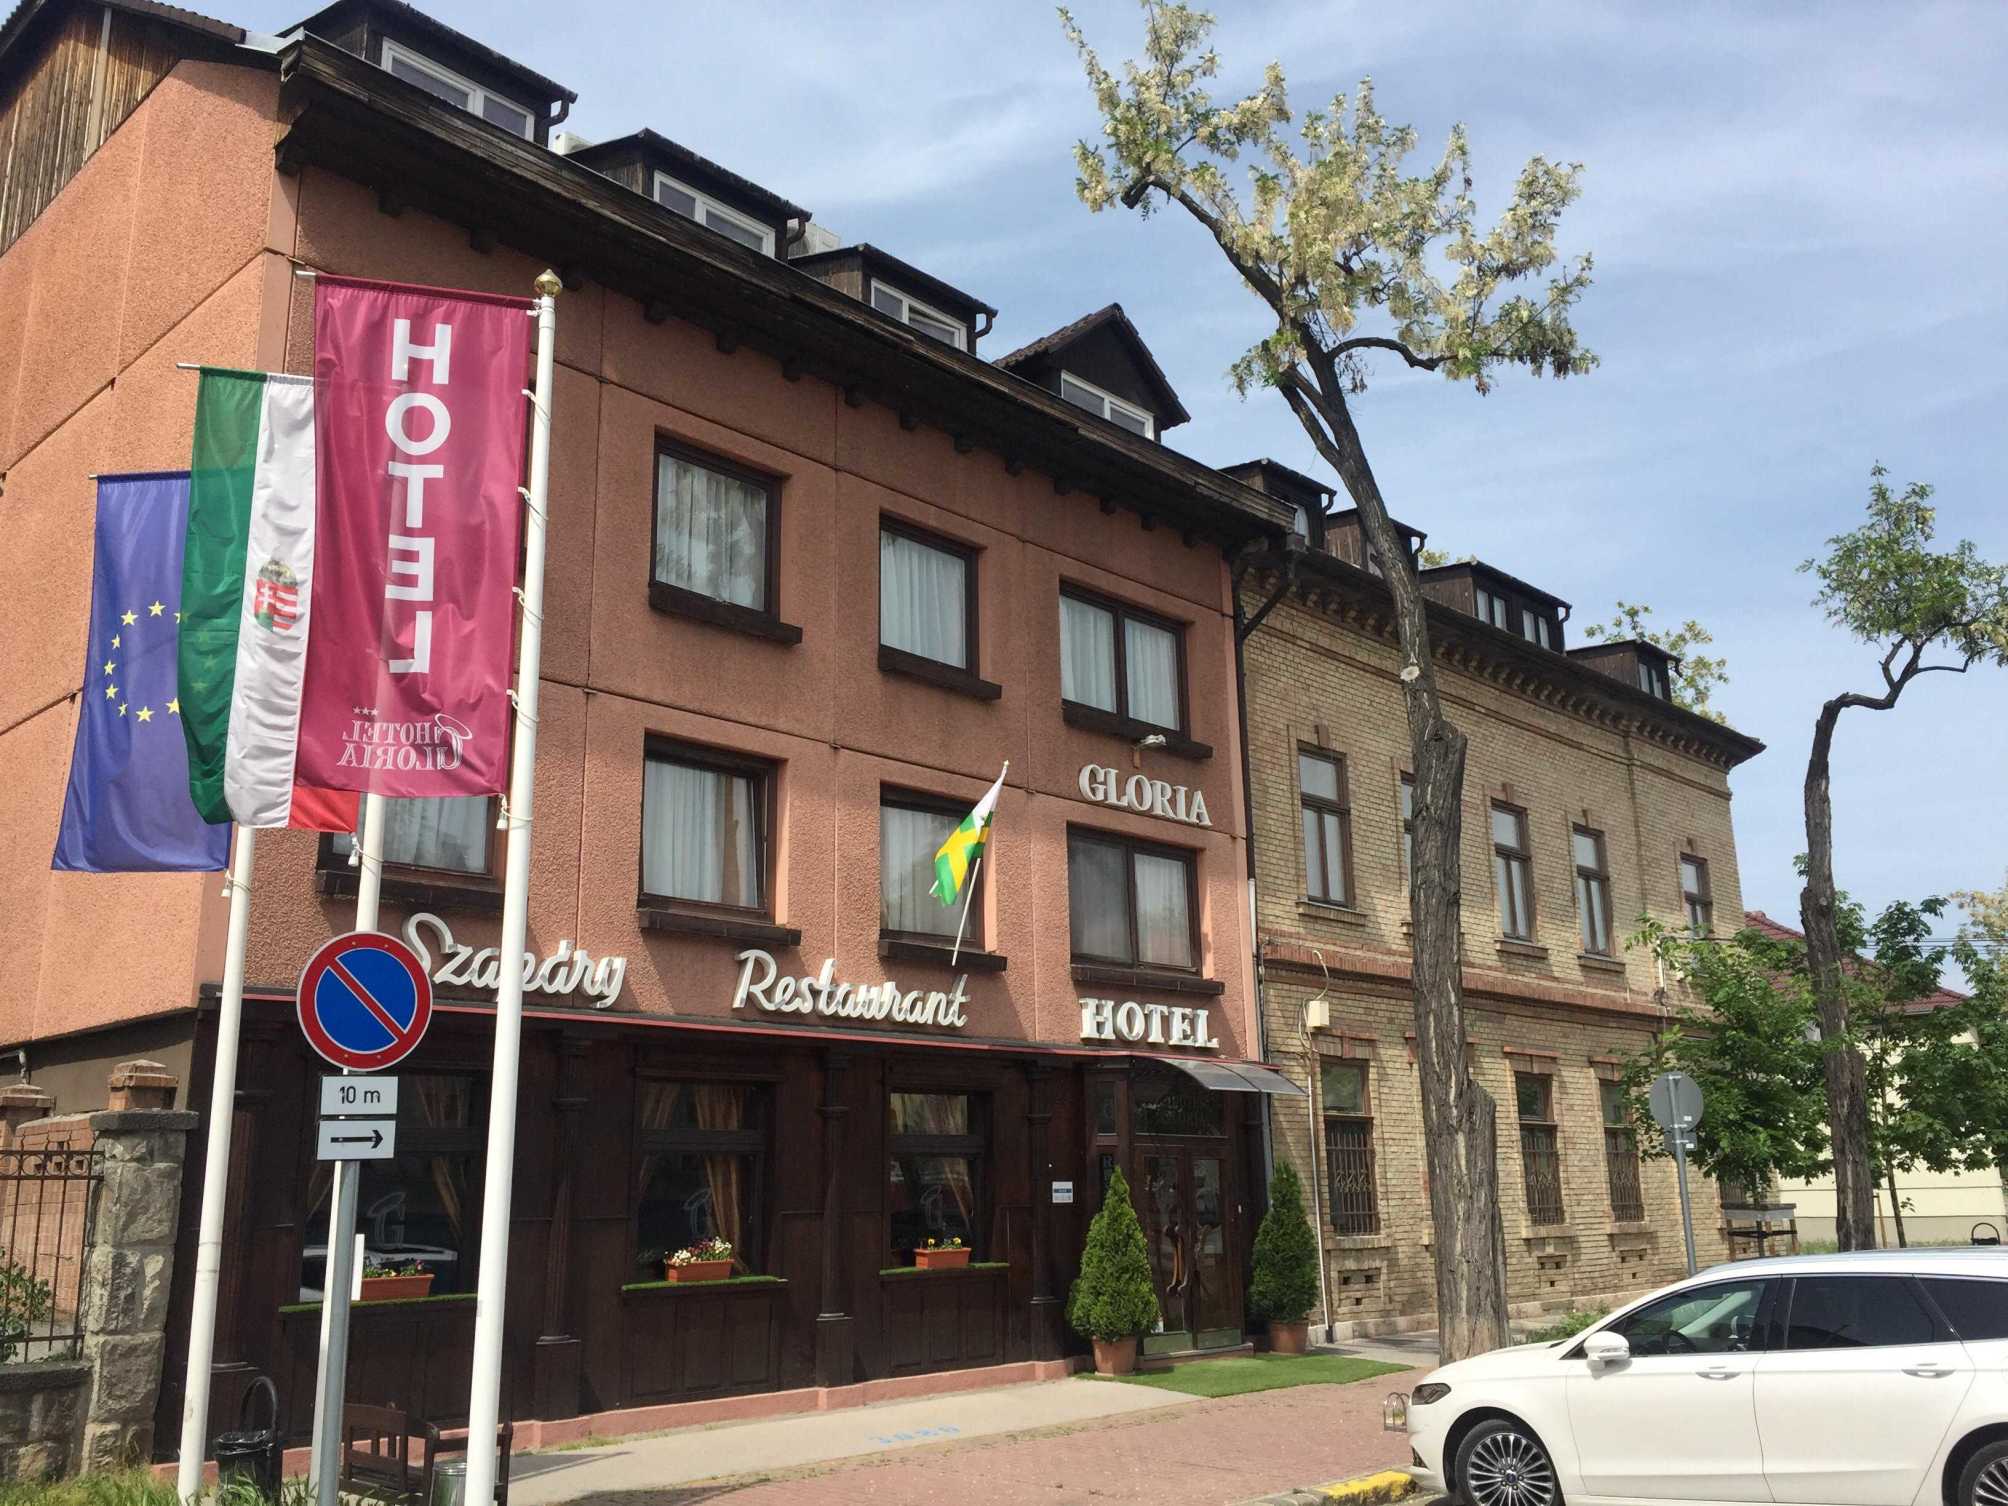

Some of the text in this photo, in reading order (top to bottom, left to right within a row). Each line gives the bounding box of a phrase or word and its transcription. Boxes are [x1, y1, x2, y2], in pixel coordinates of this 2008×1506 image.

[1079, 764, 1213, 826] GLORIA
[732, 949, 971, 1028] Restaurant
[1079, 998, 1219, 1048] HOTEL
[339, 1086, 380, 1104] 10 m
